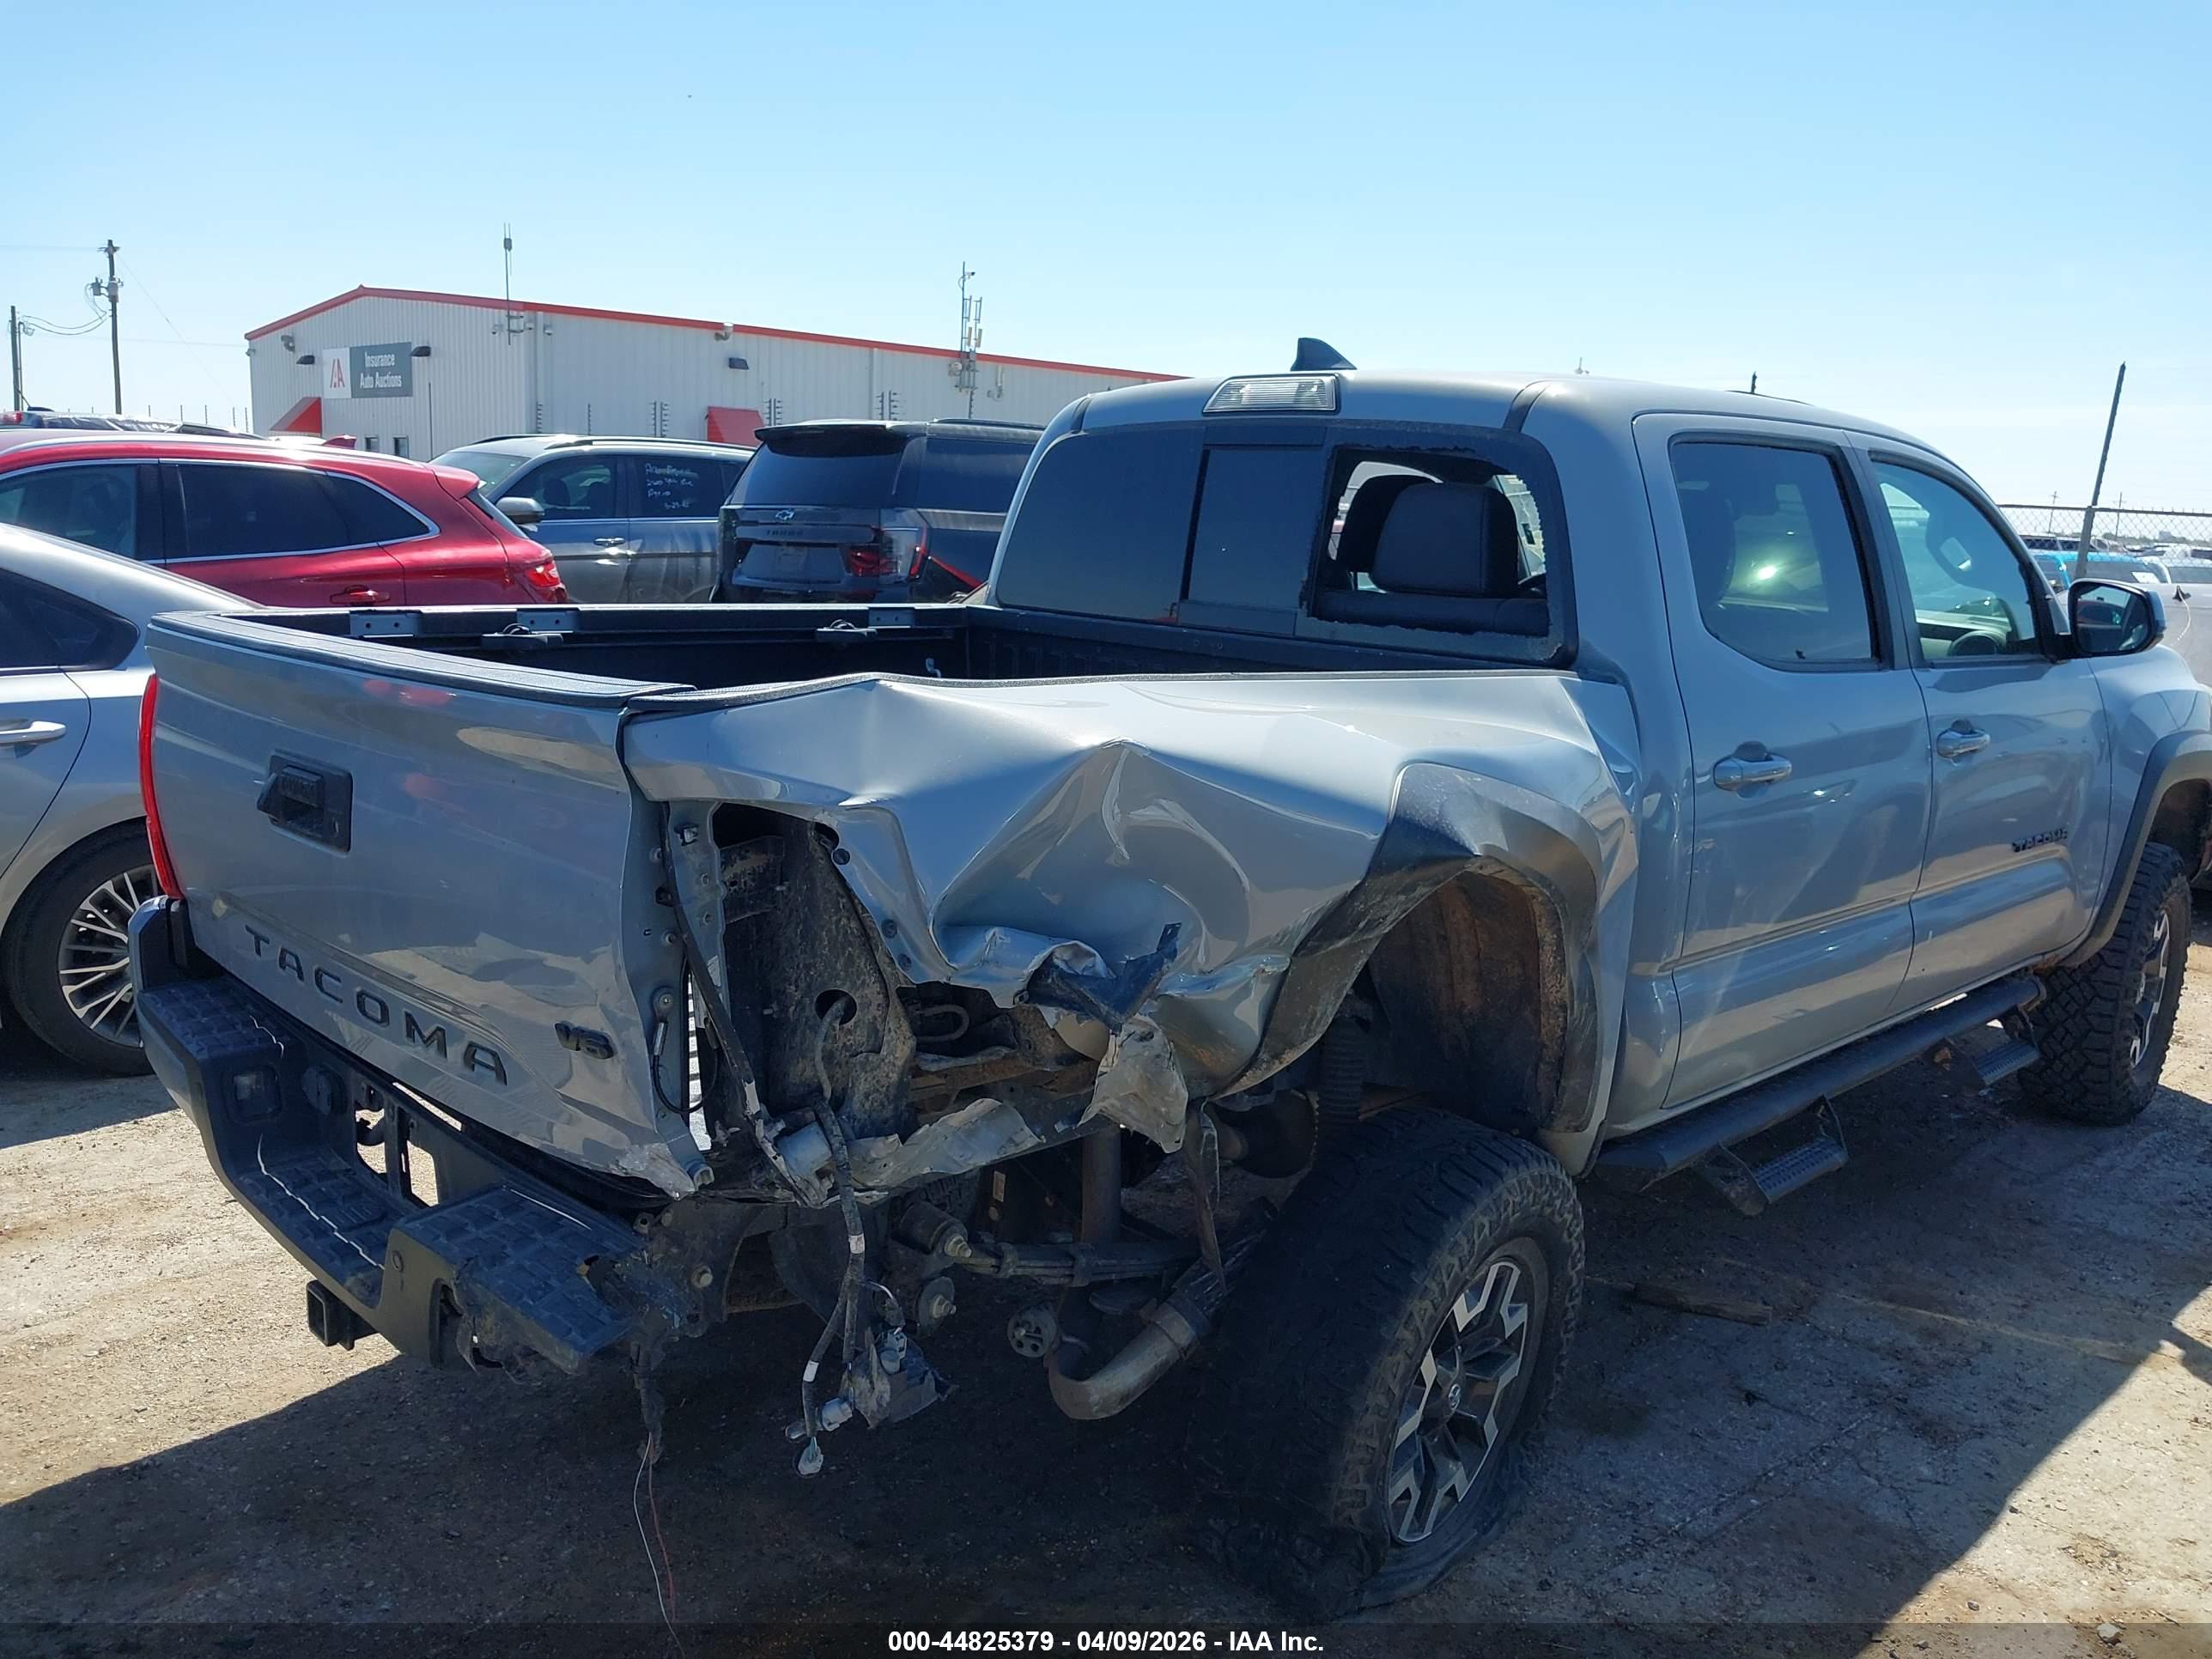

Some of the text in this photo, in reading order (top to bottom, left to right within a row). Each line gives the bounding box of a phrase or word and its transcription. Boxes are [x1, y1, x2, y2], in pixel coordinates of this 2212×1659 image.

[364, 351, 395, 368] Insurance
[360, 371, 402, 388] Auto Auctions
[244, 924, 507, 1086] TACOMA
[555, 1019, 614, 1060] V6
